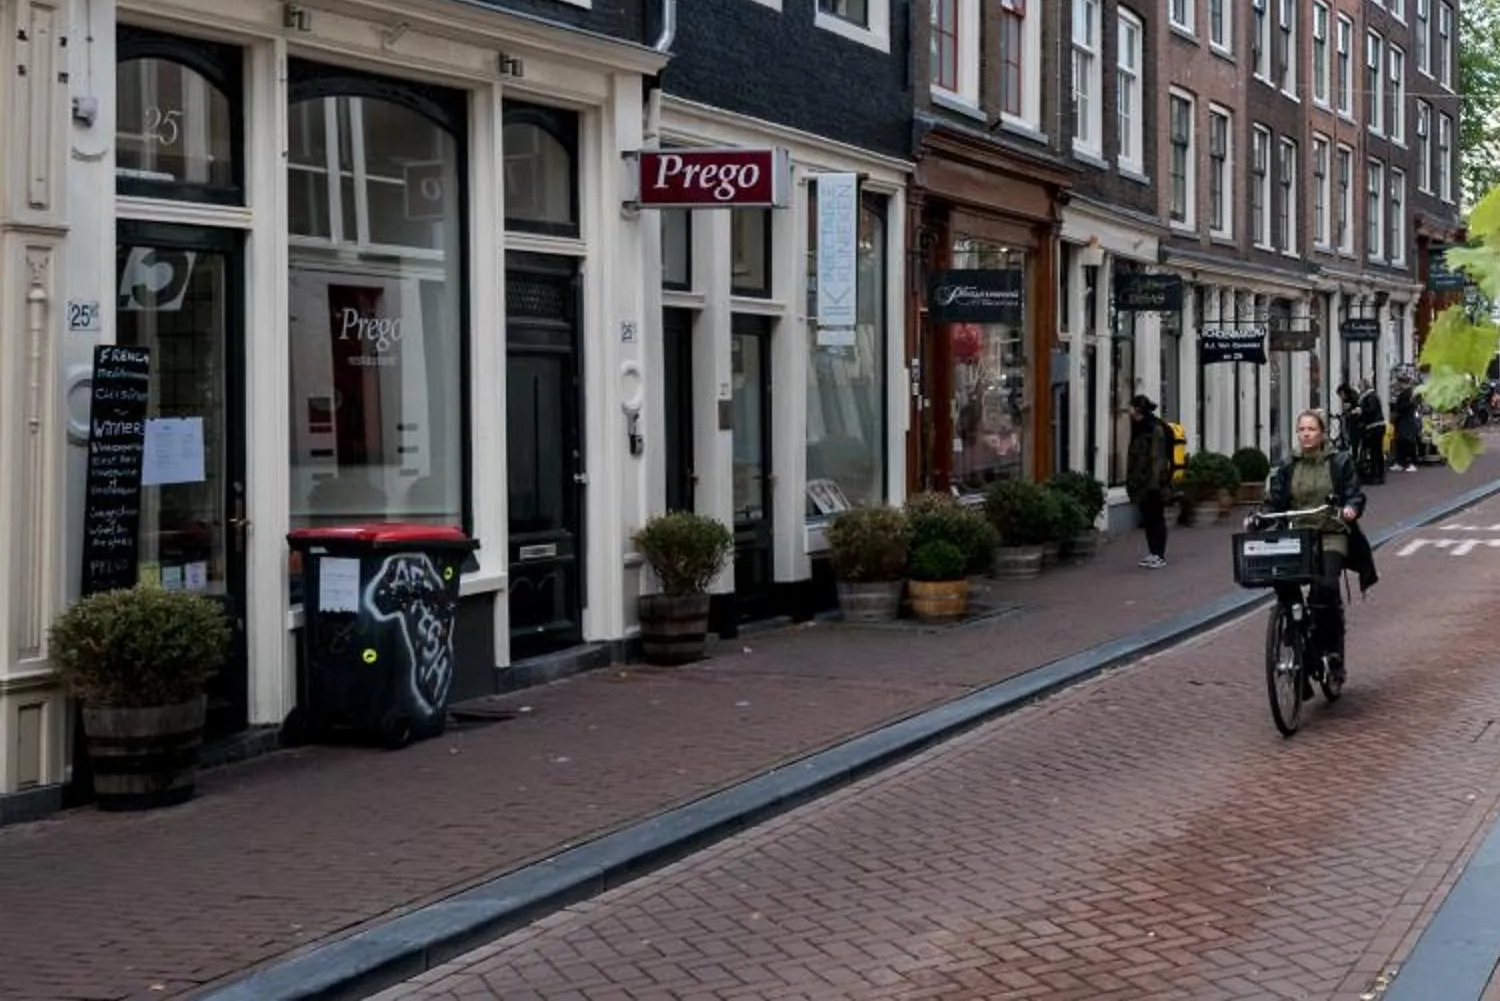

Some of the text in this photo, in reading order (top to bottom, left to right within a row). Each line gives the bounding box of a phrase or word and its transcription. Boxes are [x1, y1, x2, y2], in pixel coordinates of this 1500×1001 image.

[145, 106, 183, 145] 25
[653, 154, 760, 200] Prego
[71, 303, 91, 328] 25
[338, 307, 403, 352] Prego
